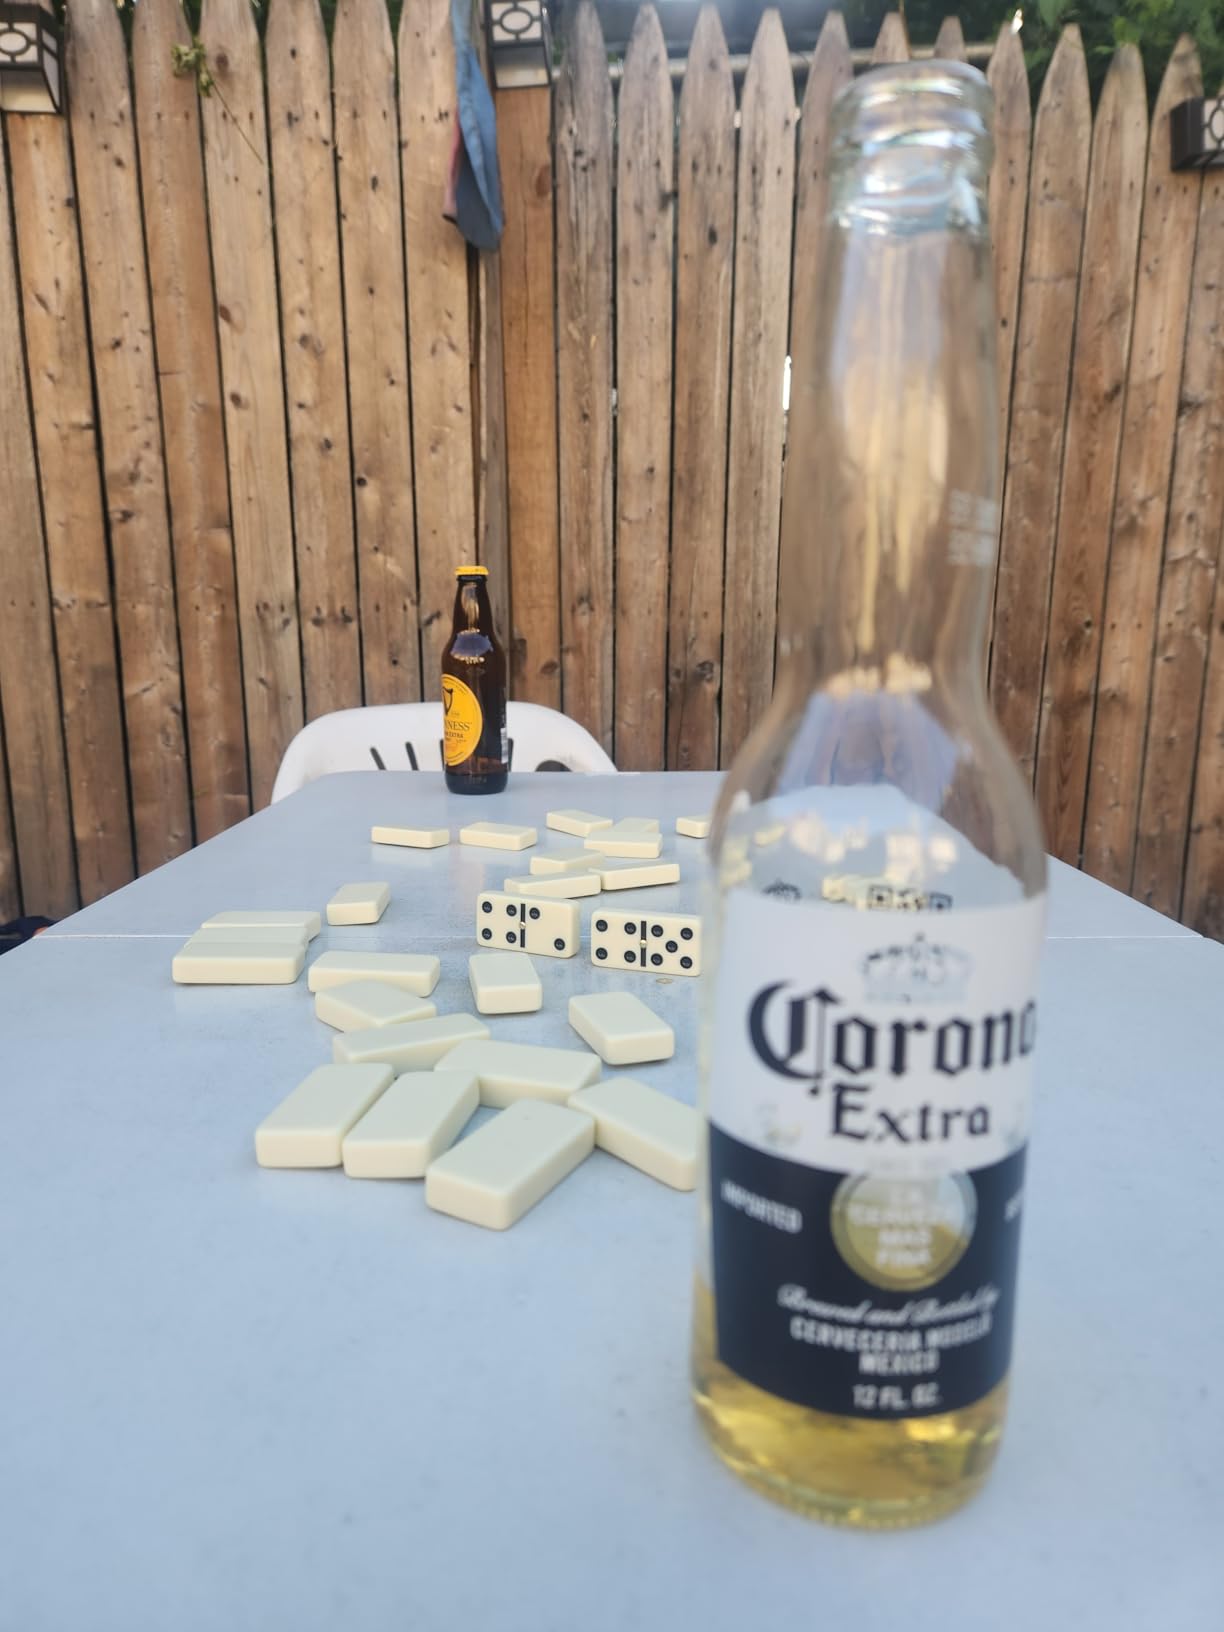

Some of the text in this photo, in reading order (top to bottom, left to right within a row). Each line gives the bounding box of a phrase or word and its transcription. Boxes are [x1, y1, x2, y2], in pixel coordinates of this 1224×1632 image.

[446, 719, 470, 731] NESS
[832, 1082, 991, 1144] Extra
[859, 1350, 940, 1376] MEXICO
[853, 1383, 878, 1410] 12
